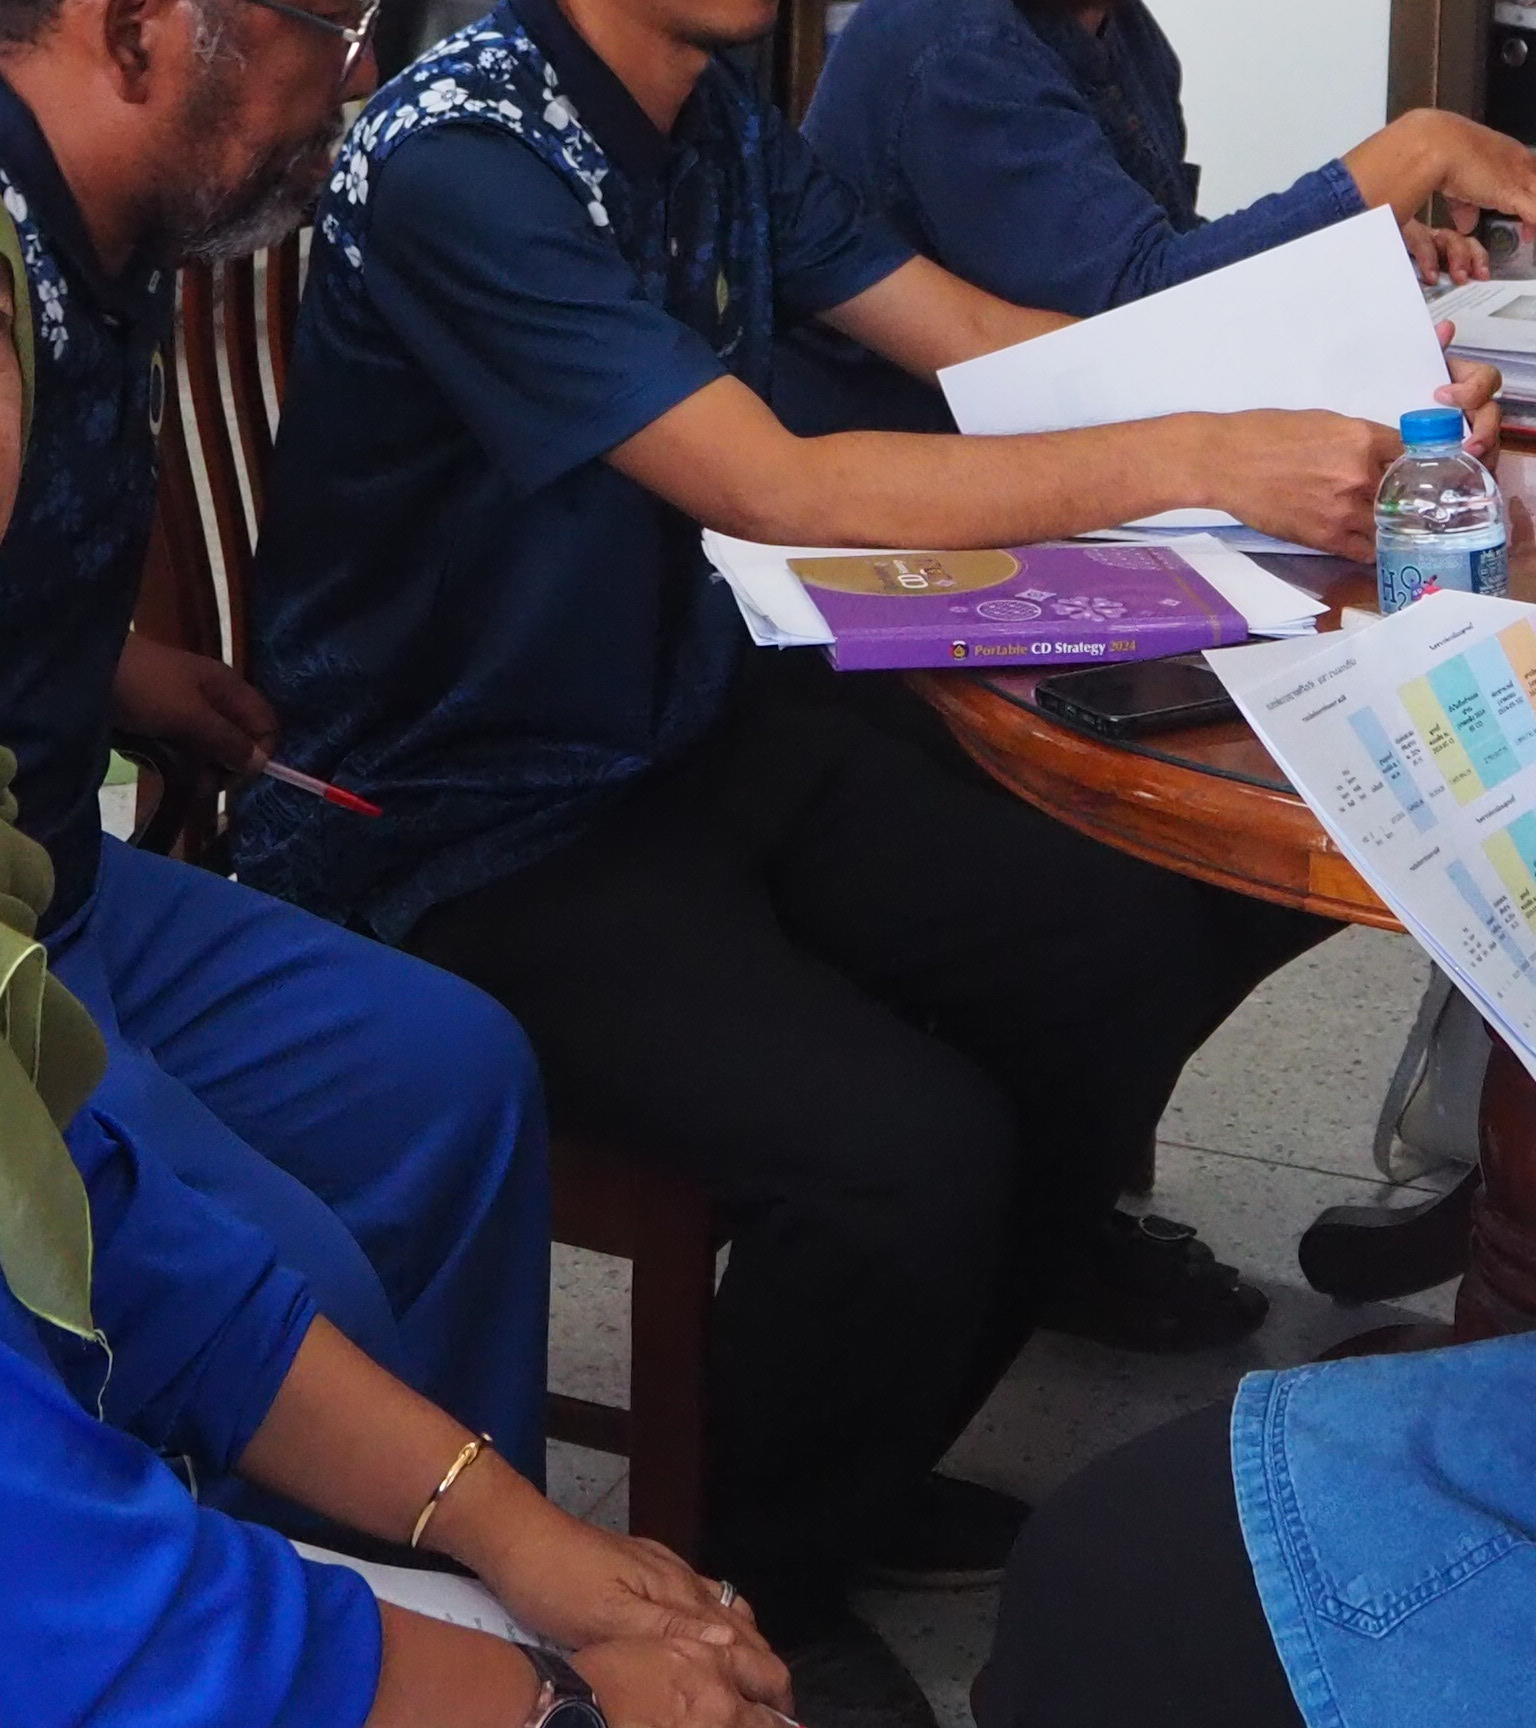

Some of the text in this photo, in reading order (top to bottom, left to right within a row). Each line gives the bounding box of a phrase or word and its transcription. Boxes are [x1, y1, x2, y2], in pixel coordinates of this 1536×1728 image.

[974, 643, 1028, 657] Portable
[1030, 641, 1052, 655] CD
[1054, 640, 1107, 657] Strategy
